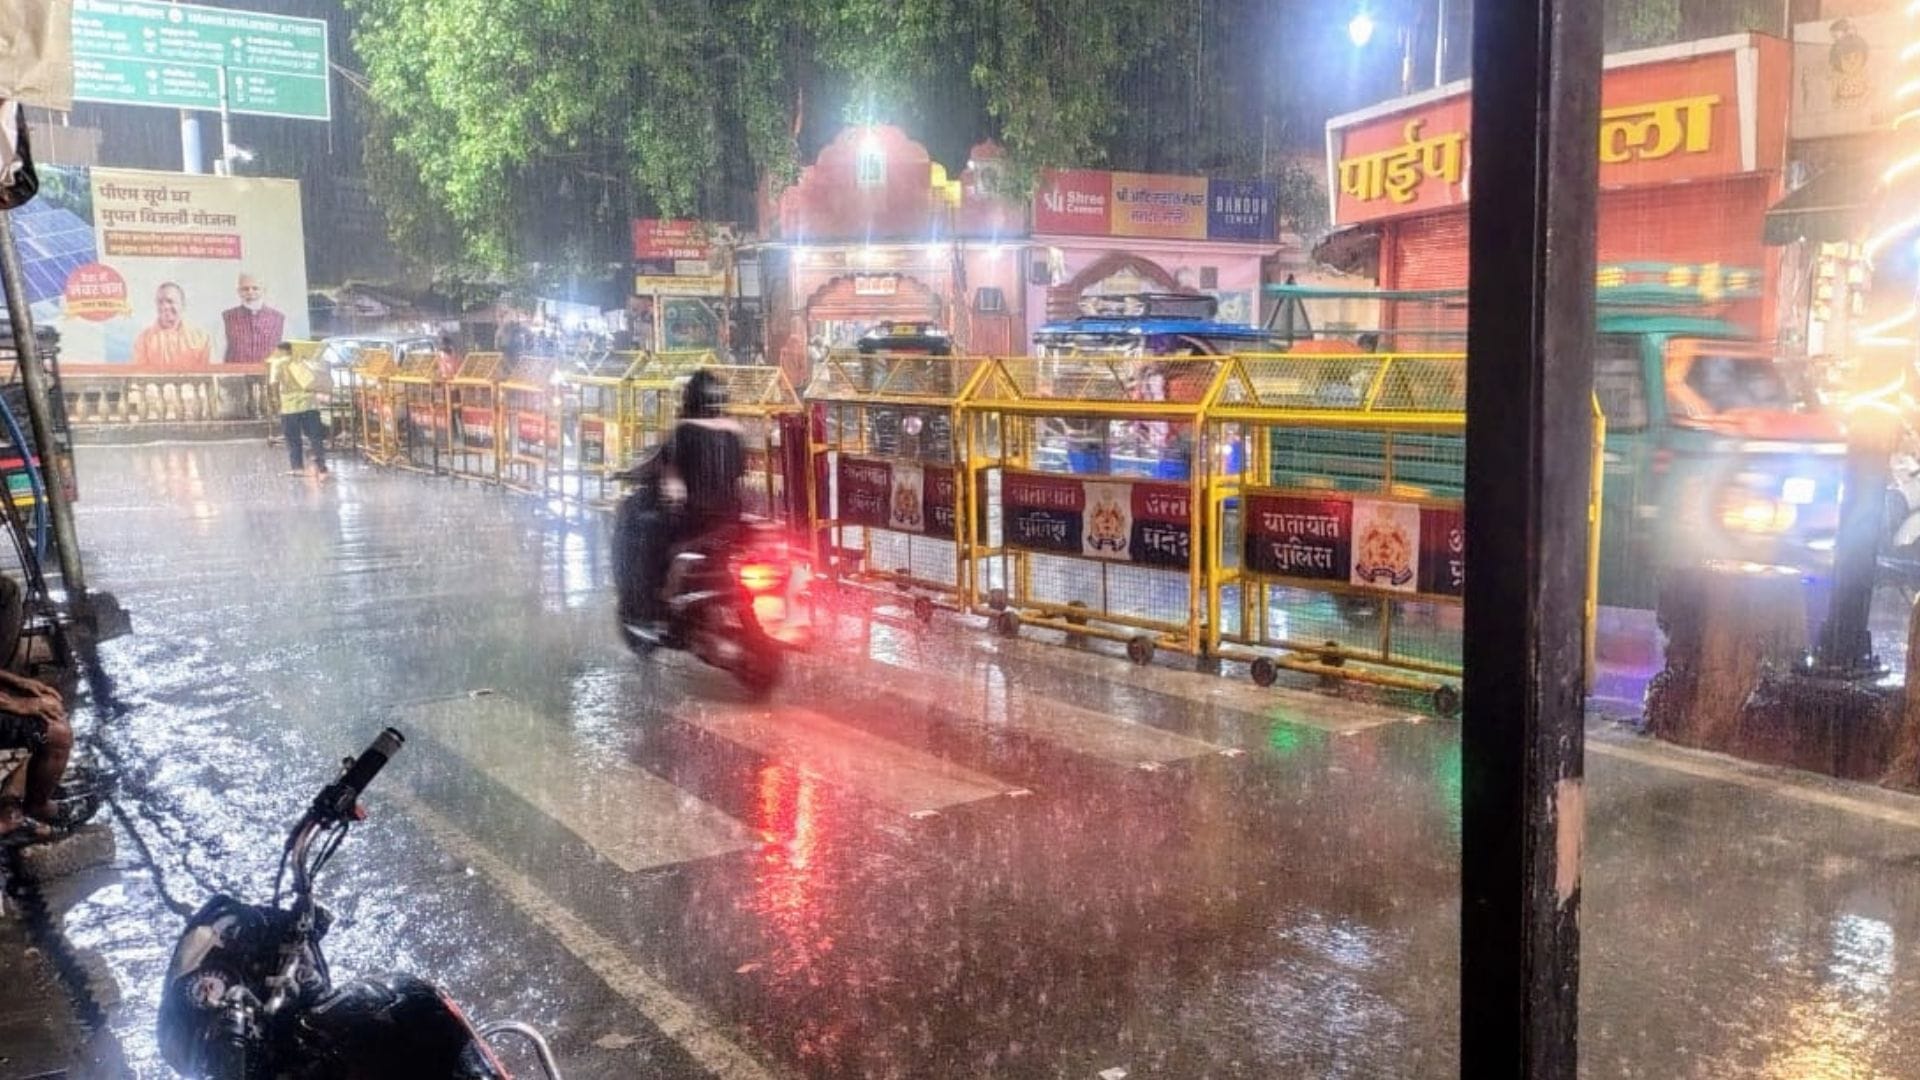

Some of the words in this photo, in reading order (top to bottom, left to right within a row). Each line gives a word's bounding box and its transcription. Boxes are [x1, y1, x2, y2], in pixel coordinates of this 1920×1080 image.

[1600, 94, 1720, 163] ला
[1339, 119, 1465, 203] पाईप
[1066, 191, 1105, 204] Shree
[1263, 512, 1339, 538] यातायात
[1272, 536, 1333, 569] पुलिस
